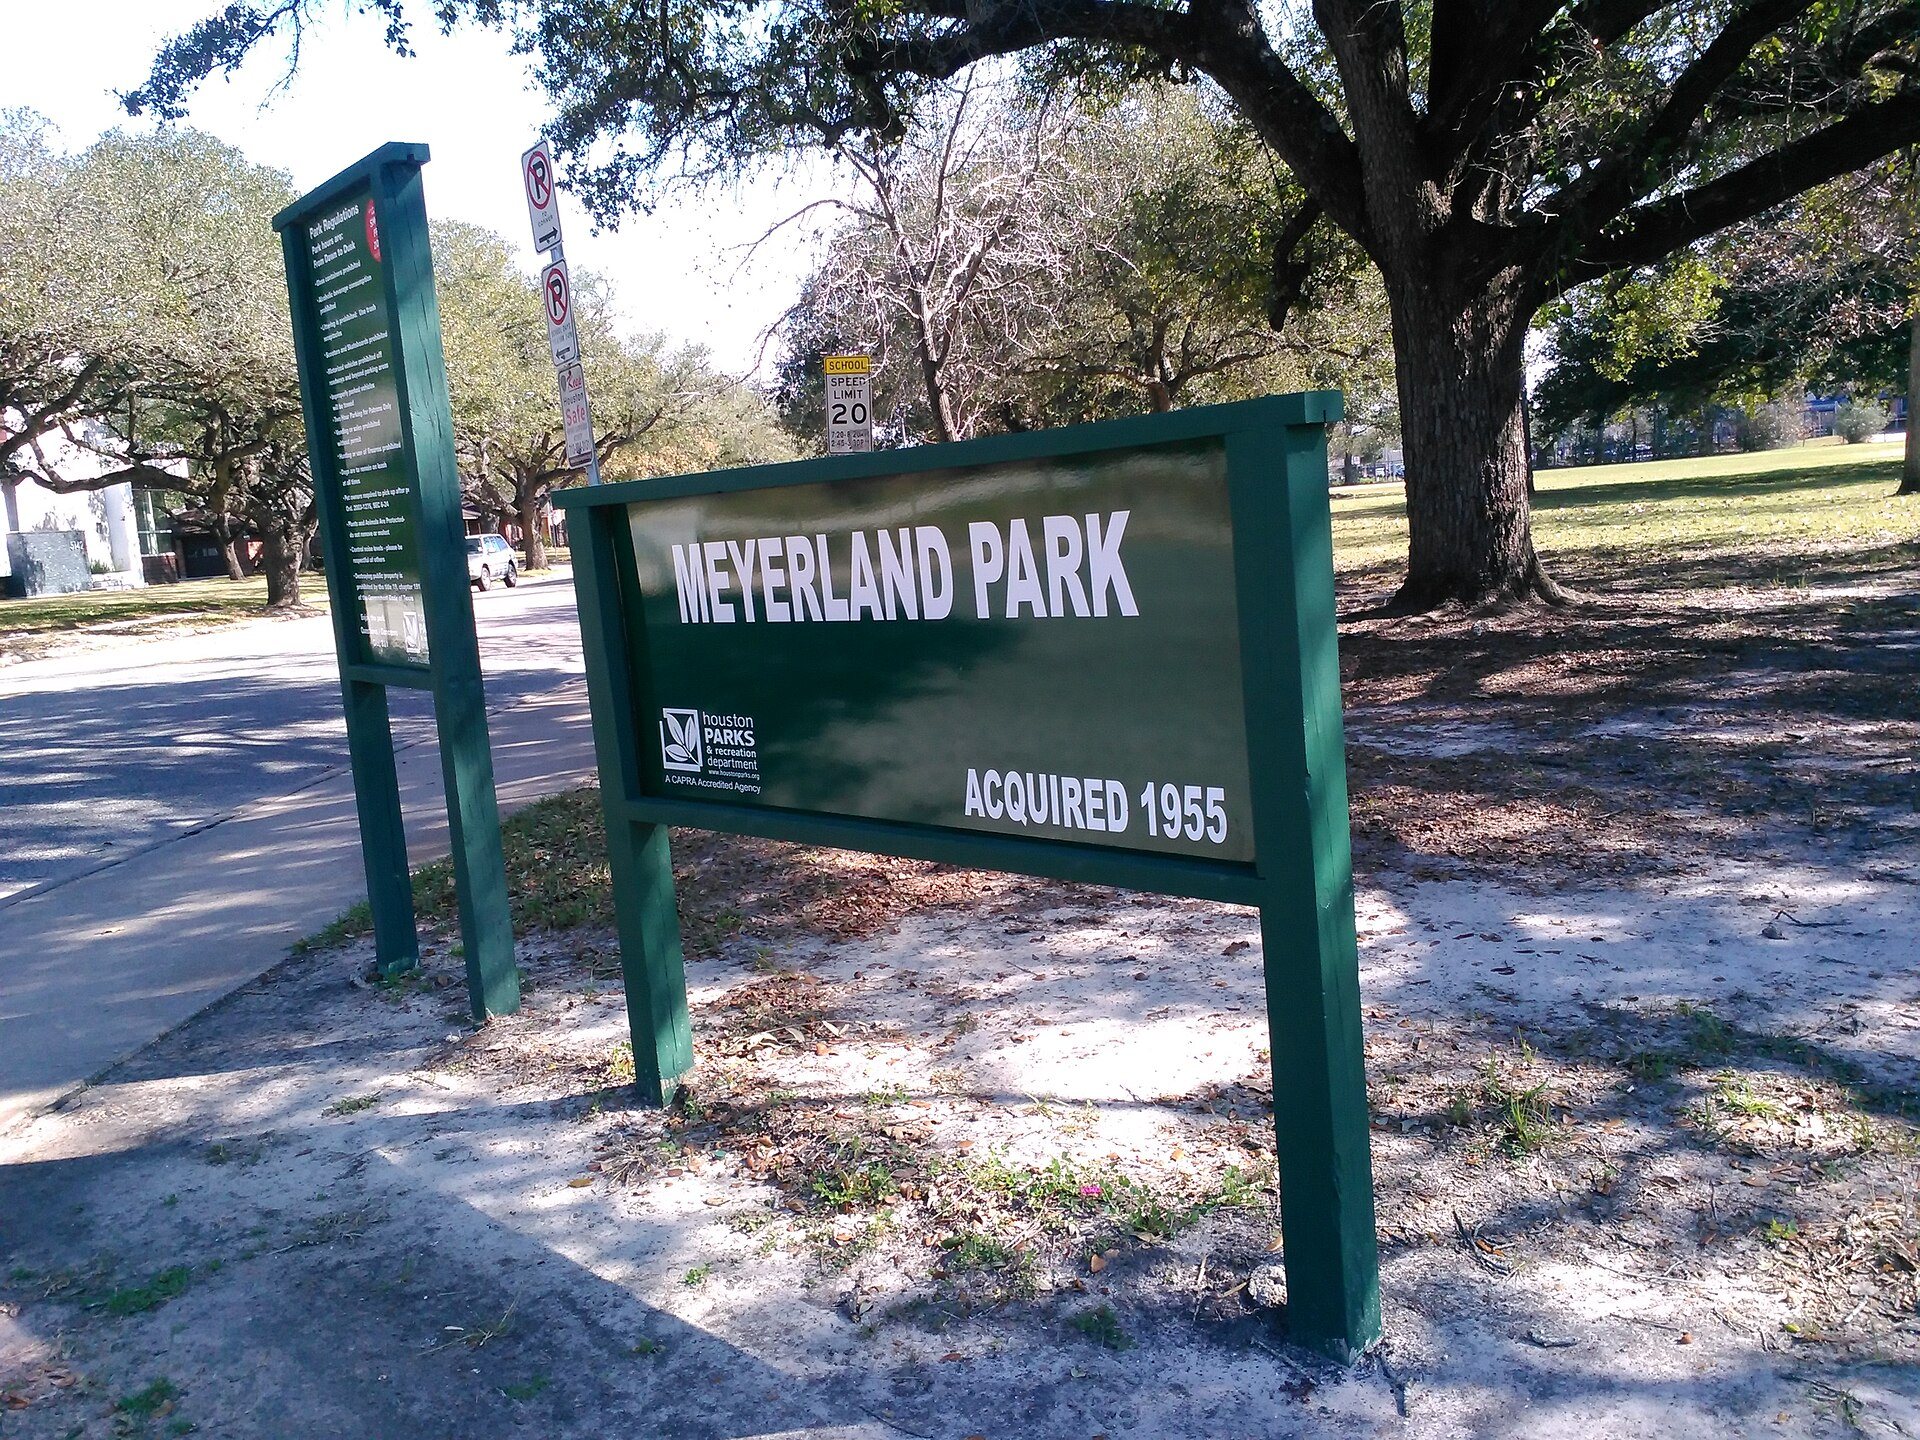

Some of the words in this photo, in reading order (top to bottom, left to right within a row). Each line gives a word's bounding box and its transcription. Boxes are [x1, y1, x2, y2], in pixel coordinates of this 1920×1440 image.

[309, 222, 323, 239] Park
[323, 205, 359, 231] Regulations
[343, 241, 356, 254] Dusk
[829, 361, 867, 370] SCHOOL
[831, 377, 866, 386] SPEED
[834, 390, 863, 399] LIMIT
[565, 405, 585, 426] Safe
[832, 403, 867, 424] 20
[672, 525, 954, 623] MEYERLAND
[968, 510, 1140, 620] PARK
[703, 711, 754, 728] houston
[704, 728, 755, 747] PARKS
[706, 745, 713, 754] &
[715, 748, 757, 758] recreation
[707, 756, 758, 771] department
[672, 776, 697, 786] CAPRA
[698, 779, 733, 790] Accredited
[734, 782, 761, 794] Agency
[964, 768, 1129, 833] ACQUIRED
[1140, 781, 1227, 844] 1955
